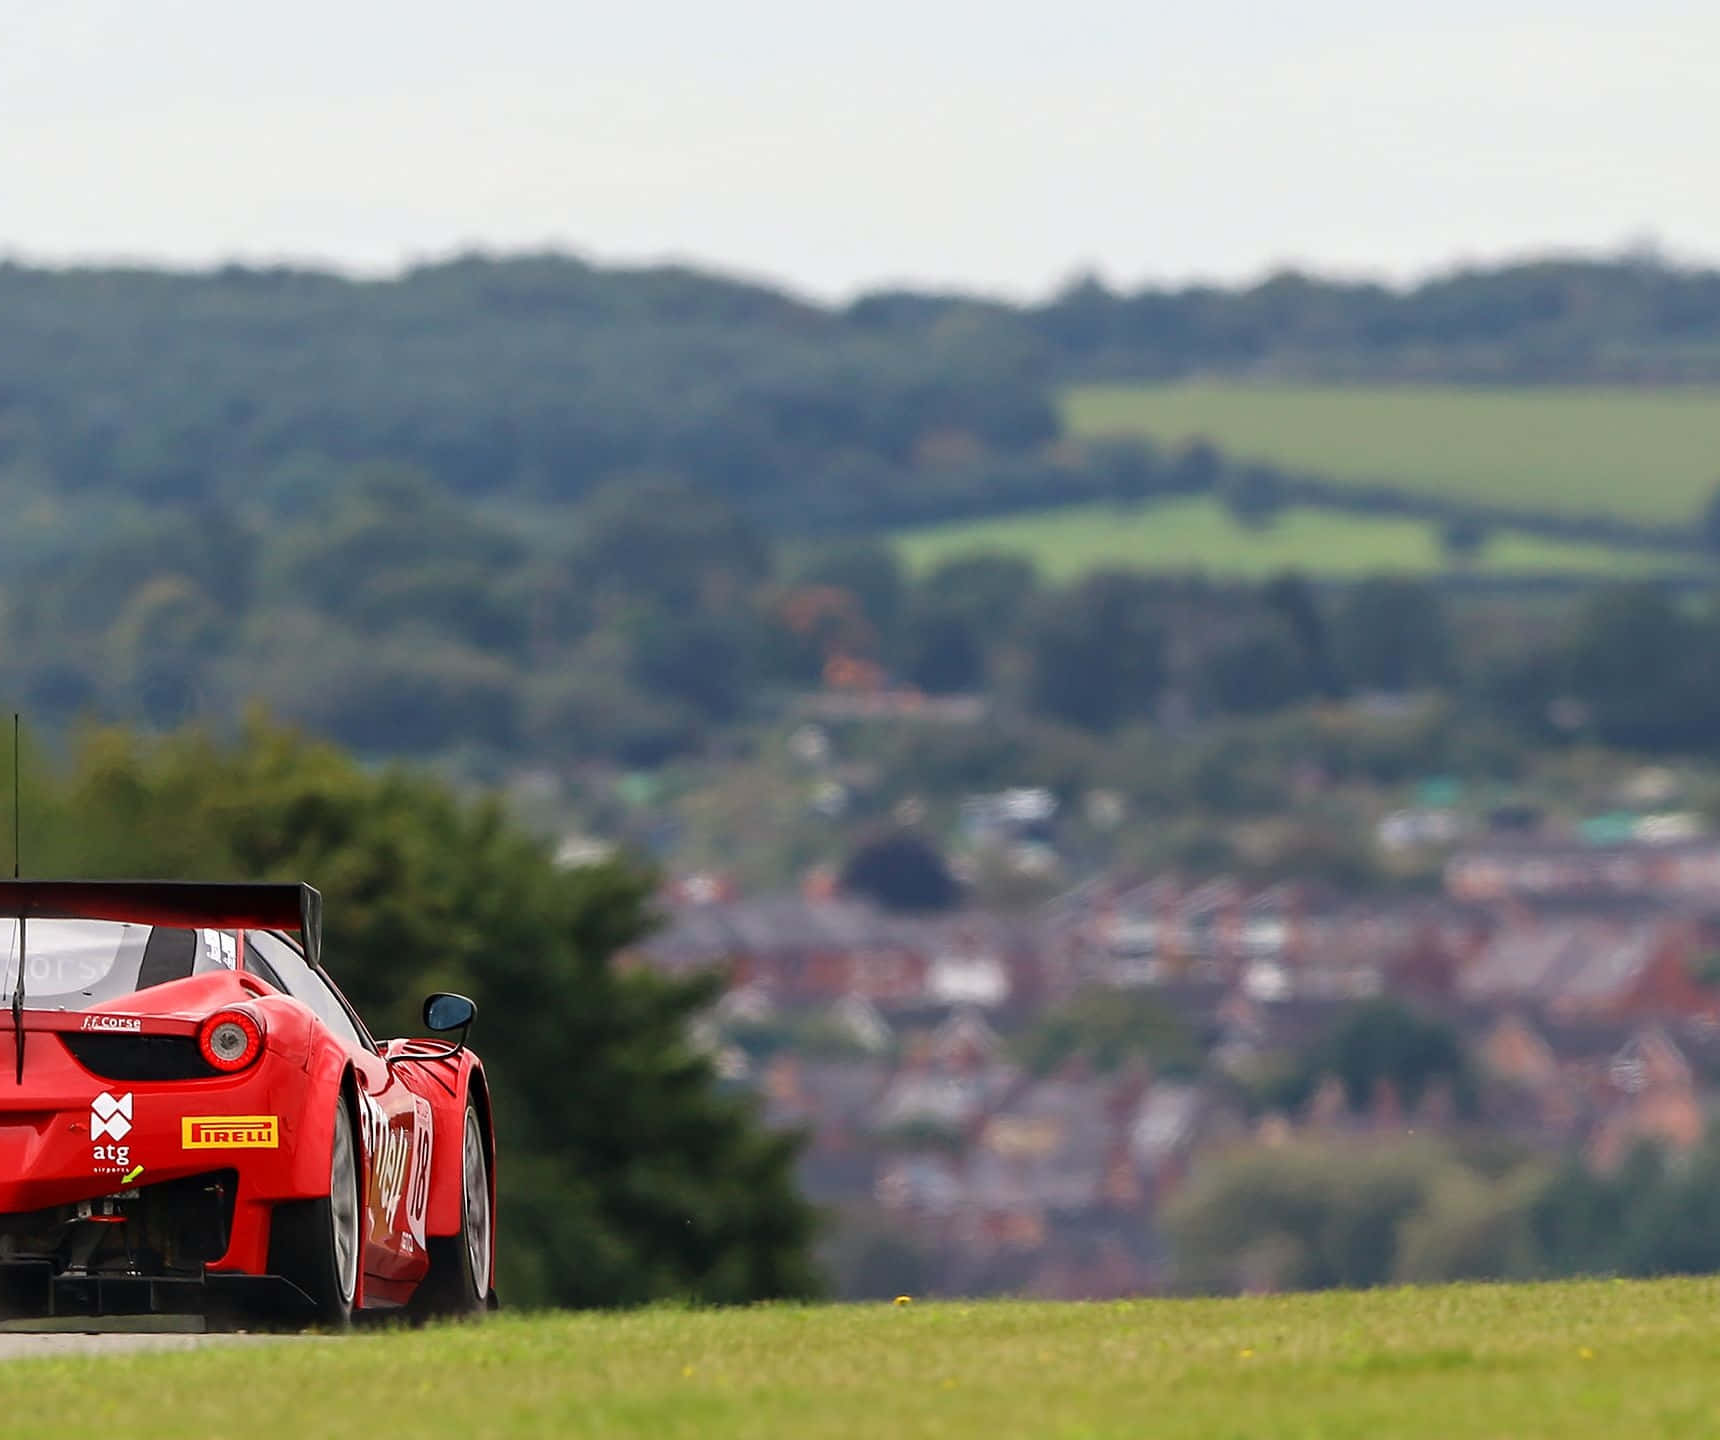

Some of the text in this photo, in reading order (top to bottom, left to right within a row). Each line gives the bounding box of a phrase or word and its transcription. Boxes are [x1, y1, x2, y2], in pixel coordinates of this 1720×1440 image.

[191, 1122, 272, 1143] PIRELLI
[93, 1144, 130, 1166] atg
[410, 1127, 429, 1221] 18
